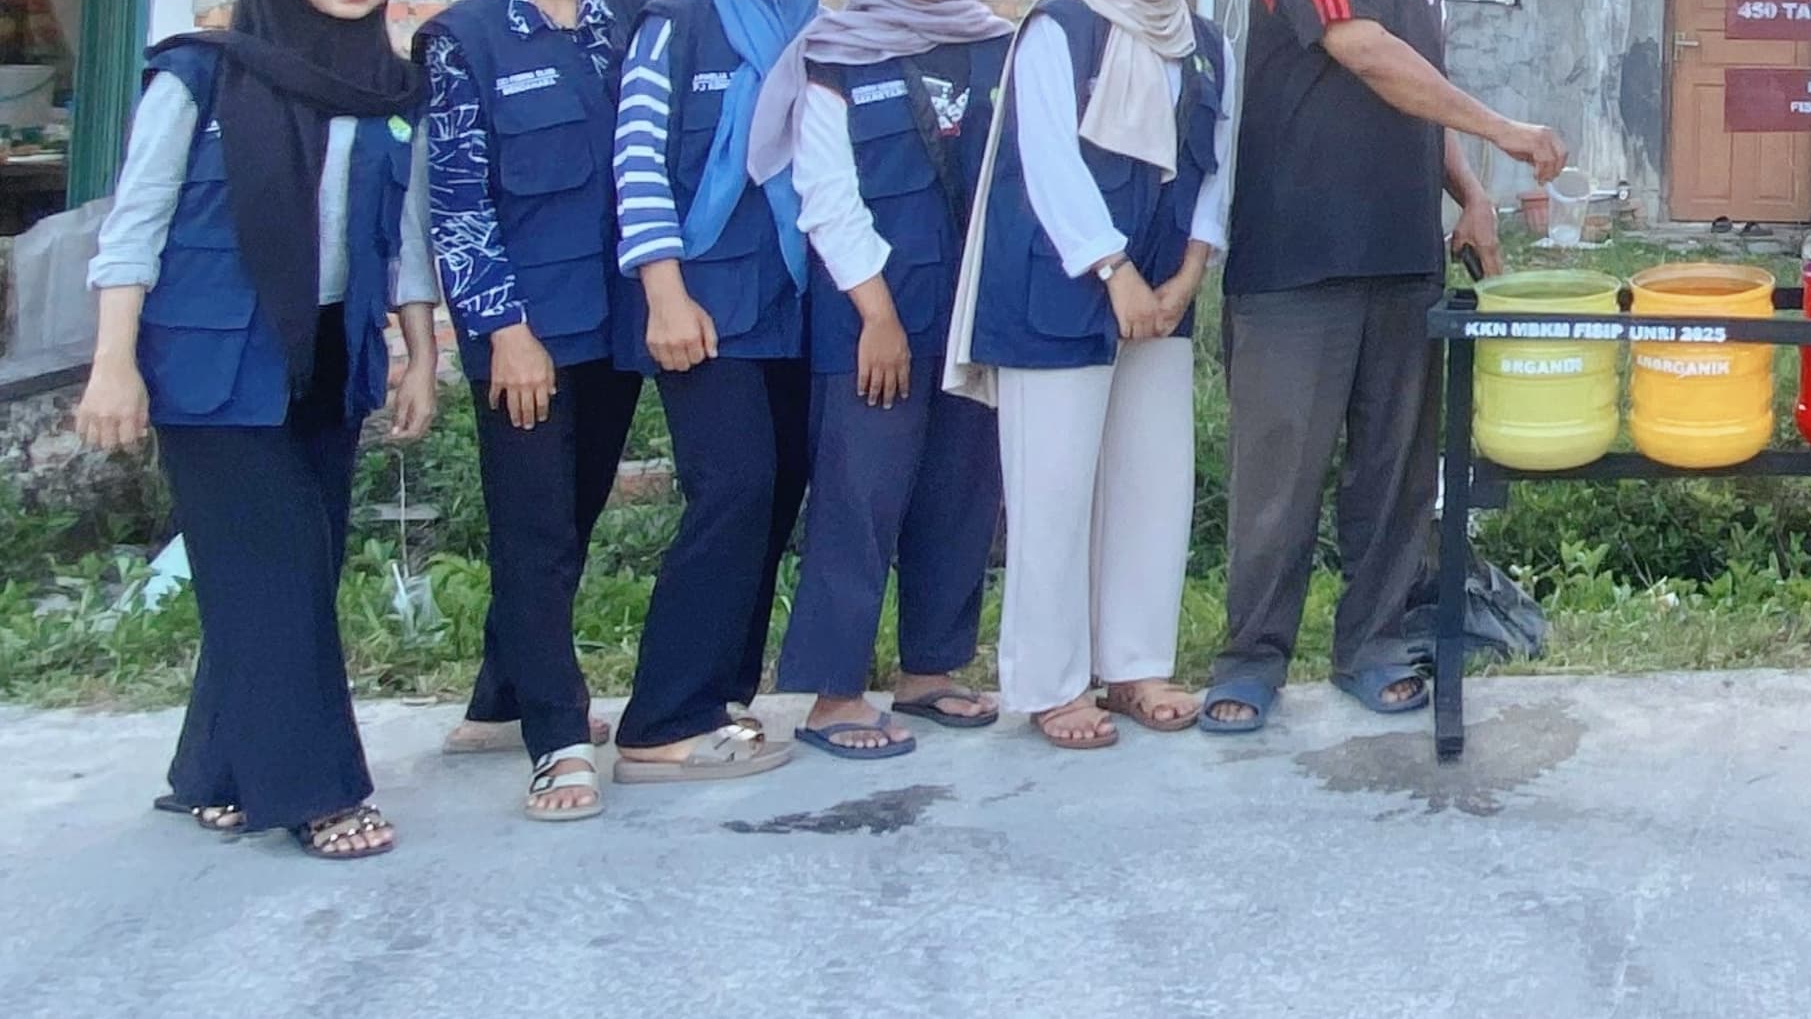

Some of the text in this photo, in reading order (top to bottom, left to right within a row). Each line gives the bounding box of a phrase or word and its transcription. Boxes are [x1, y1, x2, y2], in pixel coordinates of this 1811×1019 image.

[1737, 1, 1777, 19] 450
[1465, 321, 1726, 343] KKN MBKM FISIP UNRI 2025
[1501, 357, 1584, 375] ORGANIK
